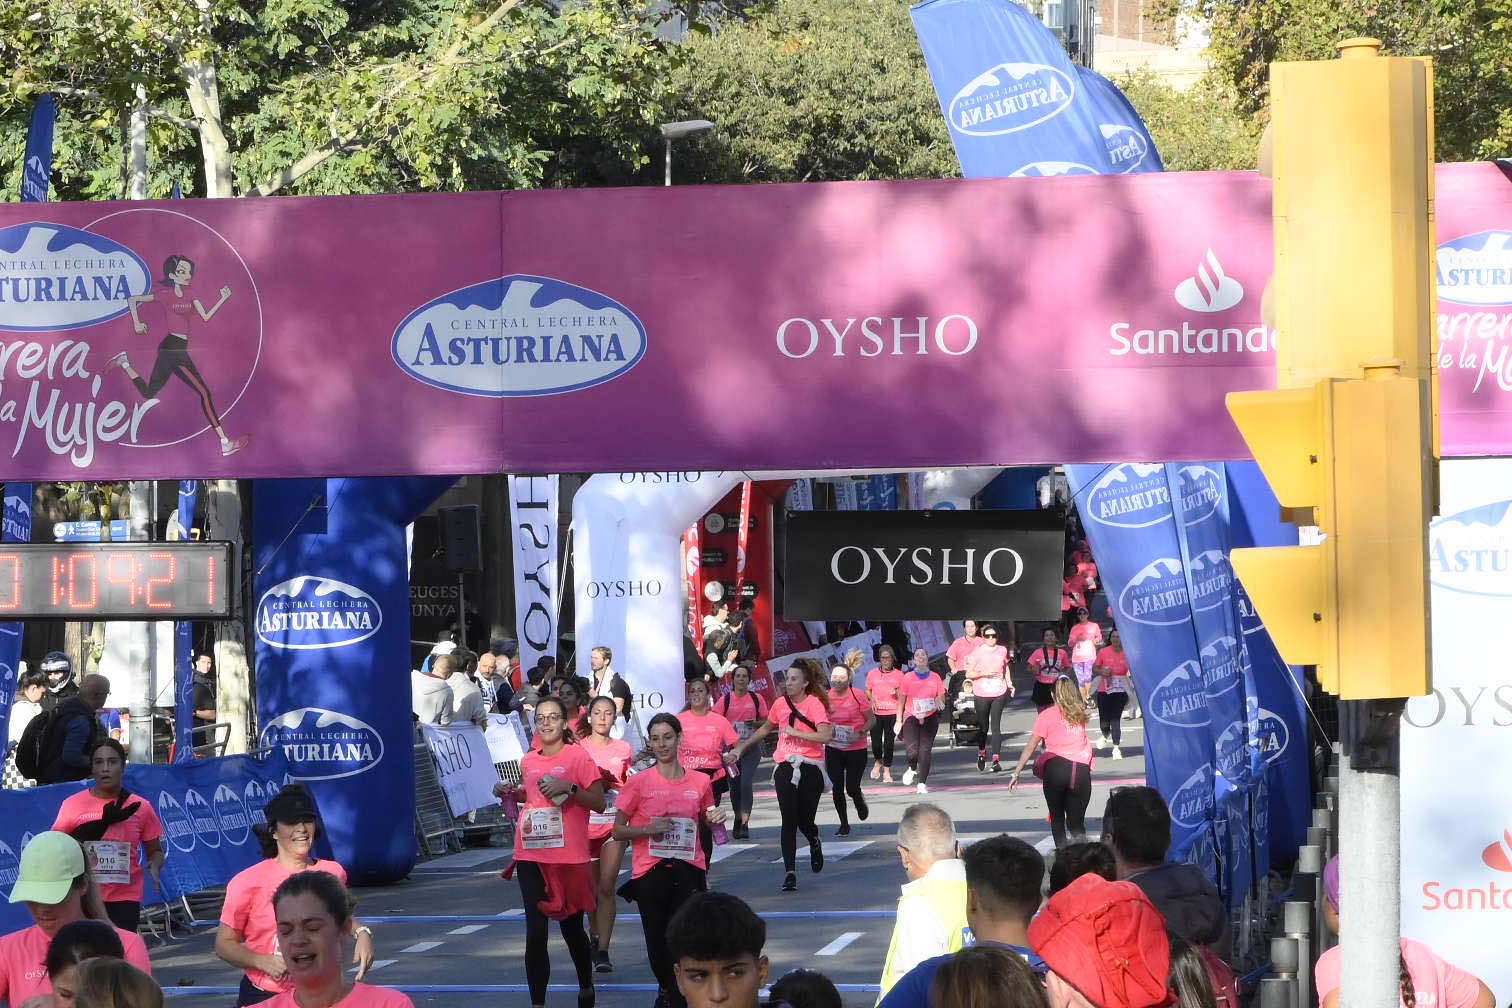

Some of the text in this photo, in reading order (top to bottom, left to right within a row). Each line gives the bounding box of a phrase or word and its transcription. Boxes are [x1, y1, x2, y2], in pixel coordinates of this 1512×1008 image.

[52, 259, 126, 271] LECHERA
[450, 315, 619, 330] CENTRAL LECHERA
[411, 322, 626, 367] ASTURIANA
[775, 313, 978, 359] OYSHO
[1109, 321, 1278, 355] Santand
[1459, 339, 1477, 369] la
[11, 371, 161, 470] Mujer
[829, 545, 1024, 588] OYSHO
[409, 585, 458, 599] EUGES
[586, 580, 662, 599] OYSHO
[319, 600, 369, 609] LECHERA
[412, 603, 457, 617] UNYA
[260, 605, 374, 632] ASTURIANA
[320, 732, 369, 741] LECHERA
[282, 743, 374, 762] TURIANA
